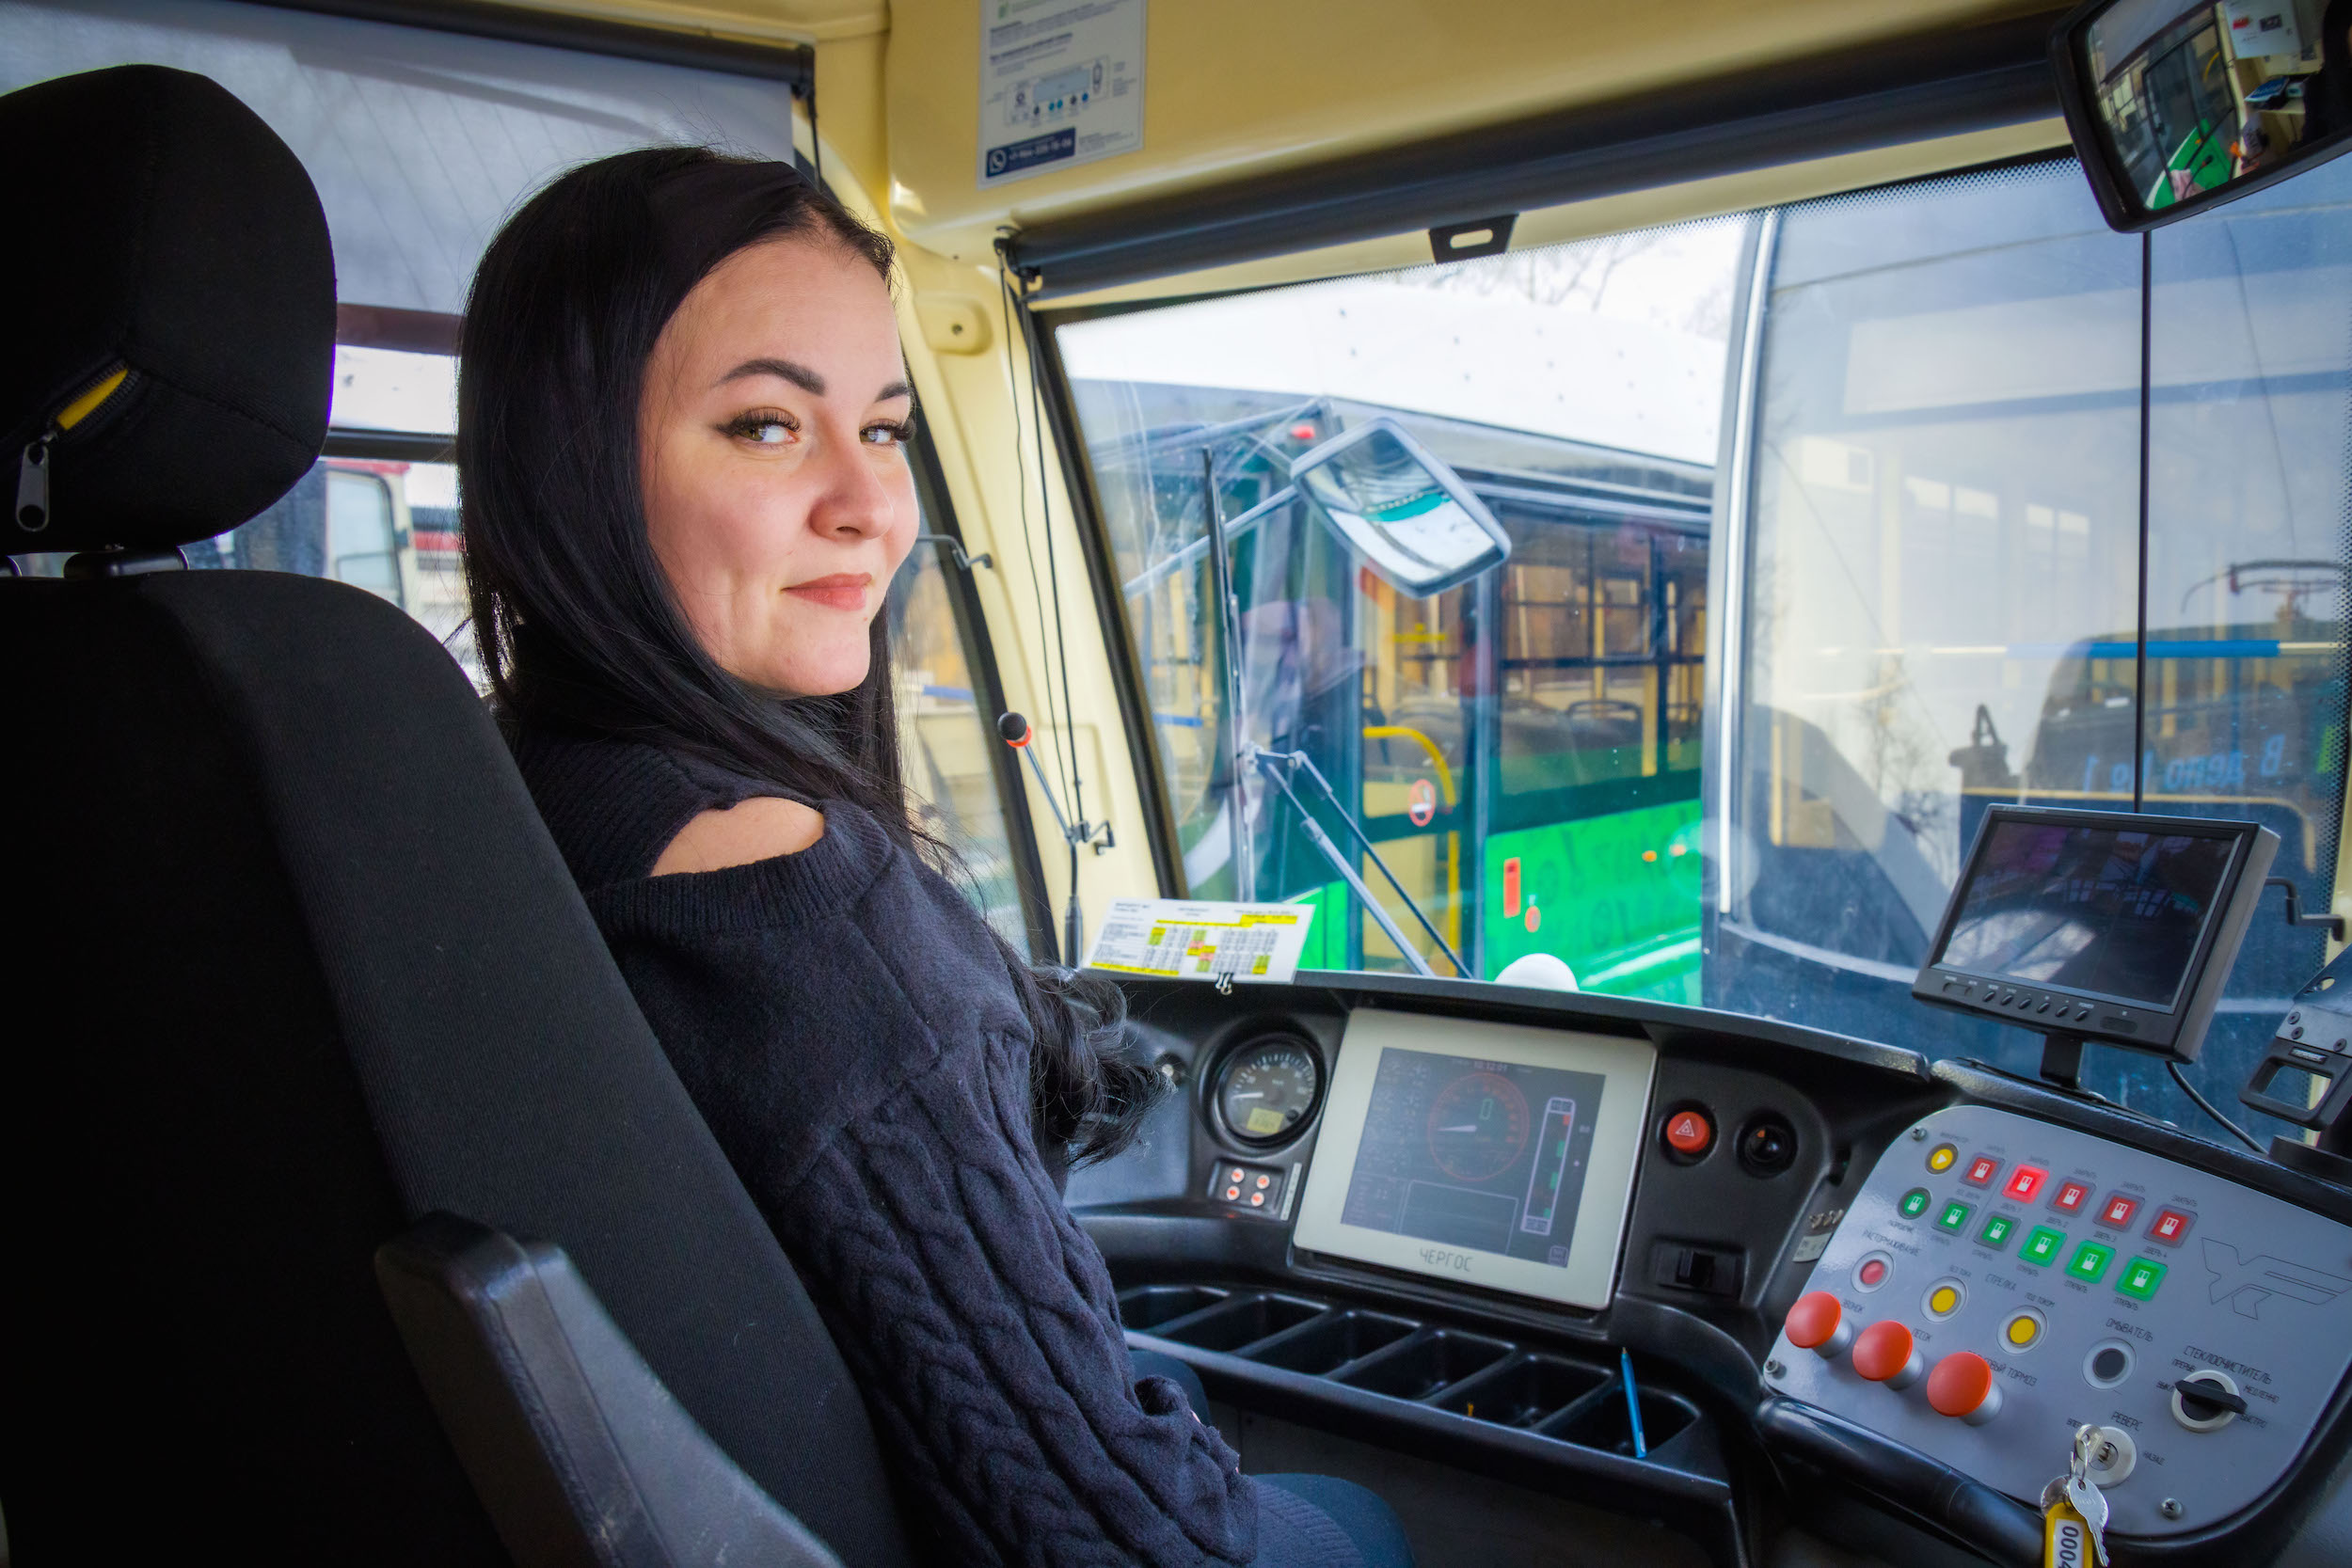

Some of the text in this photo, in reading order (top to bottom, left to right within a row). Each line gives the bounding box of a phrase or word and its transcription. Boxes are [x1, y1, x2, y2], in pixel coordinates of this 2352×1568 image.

[2172, 1195, 2197, 1207] ЗАКРЫТЬ
[1419, 1247, 1474, 1273] ЧЕРГОС
[1985, 1274, 2017, 1291] СТРЕЛКА
[2113, 1297, 2138, 1311] ОТКРЫТЬ
[2106, 1318, 2154, 1342] ОМЫВАТЕЛЬ
[2183, 1345, 2274, 1385] СТЕКЛООЧИСТИТЕЛЬ
[2007, 1367, 2038, 1386] ТОРМОЗ
[2243, 1385, 2280, 1403] МЕДЛЕННО
[2111, 1411, 2143, 1432] РЕВЕРС
[2142, 1450, 2166, 1465] НАЗАД
